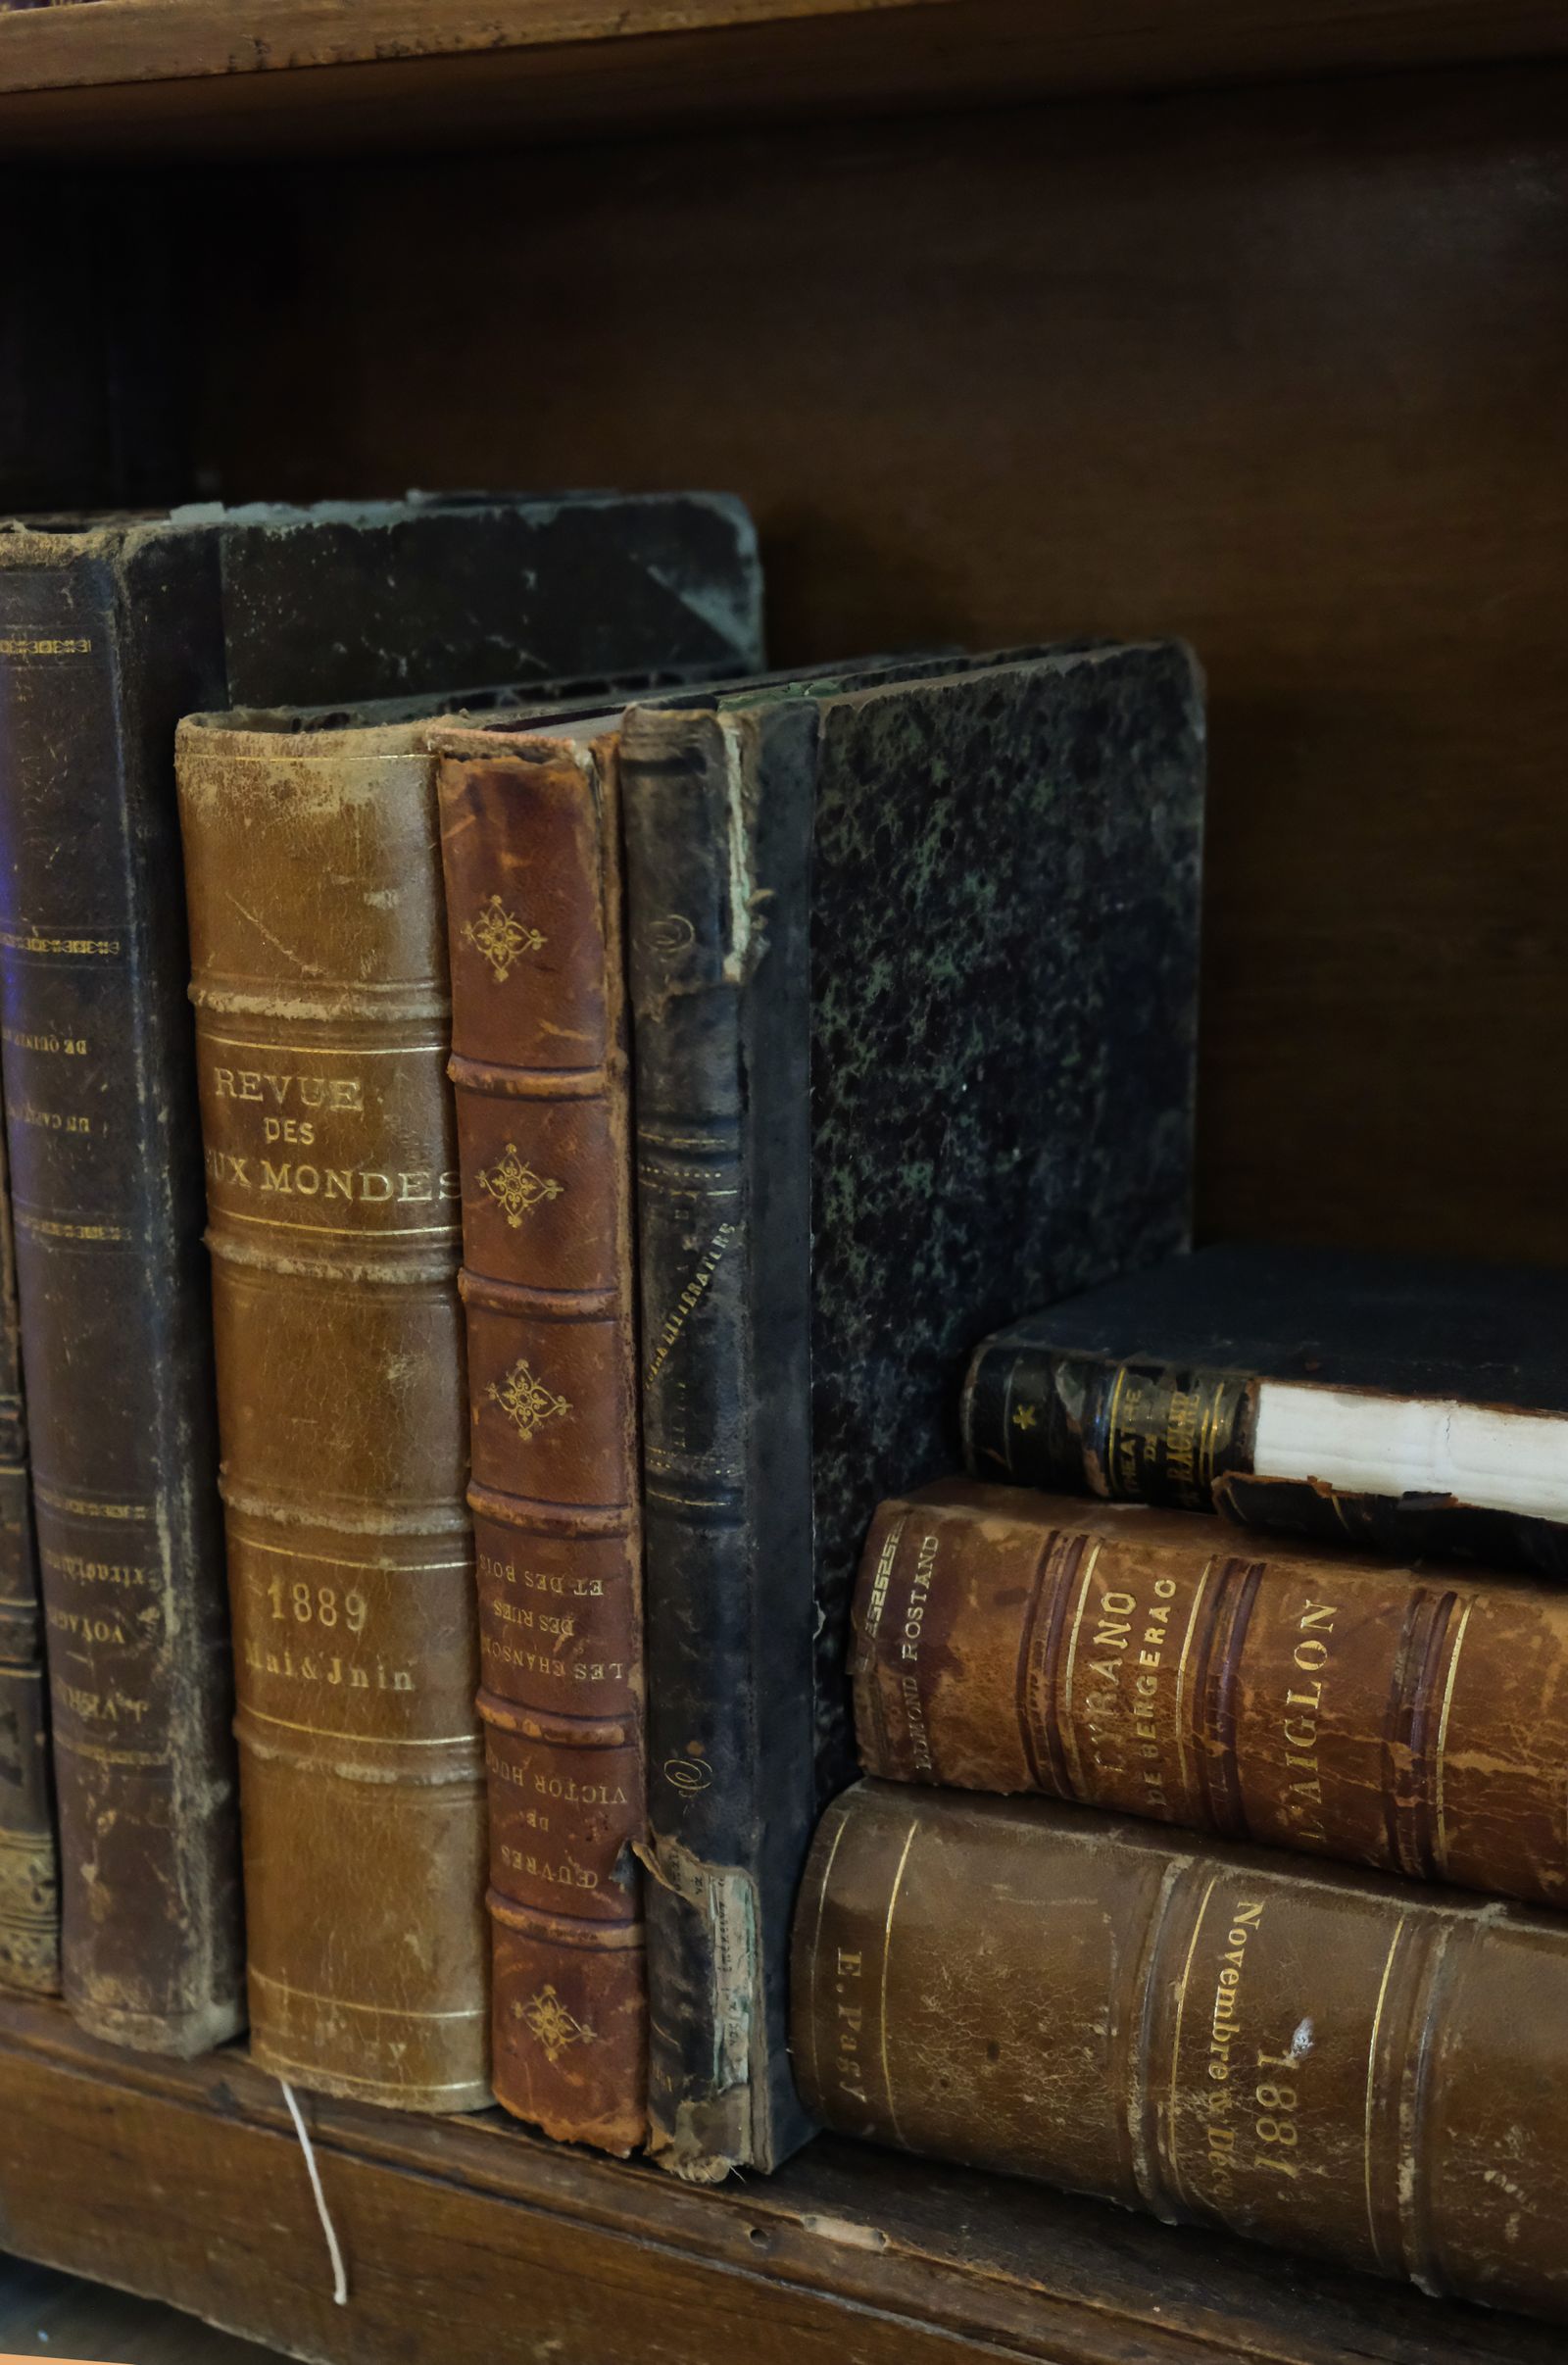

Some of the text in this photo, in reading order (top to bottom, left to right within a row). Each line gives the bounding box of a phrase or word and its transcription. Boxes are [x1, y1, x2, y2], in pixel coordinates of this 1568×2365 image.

[214, 1067, 364, 1112] REVUE
[264, 1116, 315, 1146] DES
[206, 1150, 462, 1204] UX MONDES
[478, 1552, 605, 1598] ET DES BOIS
[268, 1574, 368, 1632] 1889
[493, 1600, 574, 1637] DES RUES
[301, 1656, 318, 1680] &
[572, 1661, 623, 1680] LES
[901, 1535, 939, 1770] EDMOND ROSTAND
[1131, 1577, 1177, 1759] BERGERAC
[1086, 1590, 1137, 1772] CYRANO
[532, 1775, 628, 1805] VICTOR
[498, 1844, 600, 1890] ŒUVRES
[837, 1946, 862, 1995] E.
[1208, 1899, 1265, 2080] Novembre
[1253, 2047, 1300, 2180] 1881
